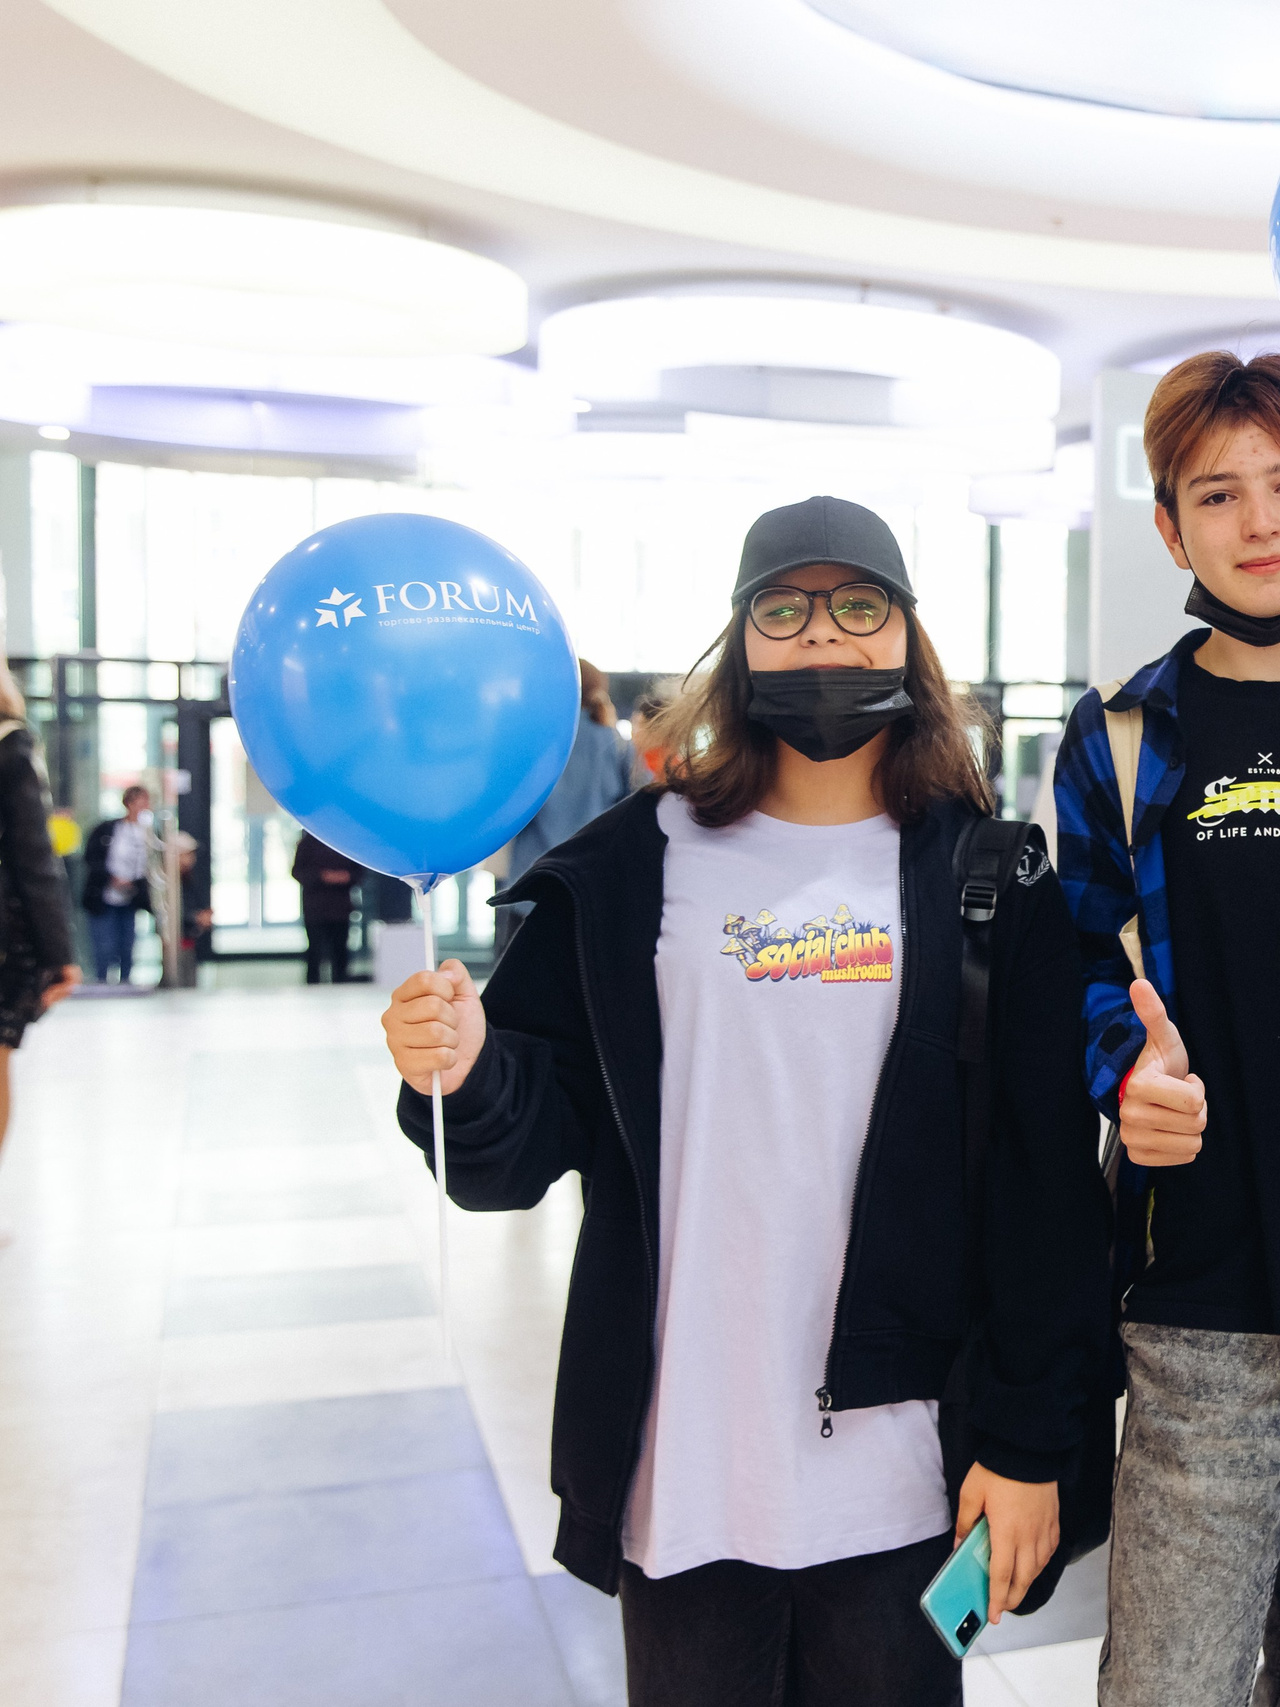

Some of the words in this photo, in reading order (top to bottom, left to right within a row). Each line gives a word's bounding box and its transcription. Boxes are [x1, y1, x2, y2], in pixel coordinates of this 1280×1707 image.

[372, 581, 539, 623] FORUM
[378, 615, 514, 628] торгово-развлекательный
[516, 622, 541, 635] центр
[1196, 830, 1213, 841] OF
[1220, 827, 1247, 839] LIFE
[745, 929, 834, 982] social
[833, 927, 895, 964] club
[821, 963, 893, 983] mushrooms
